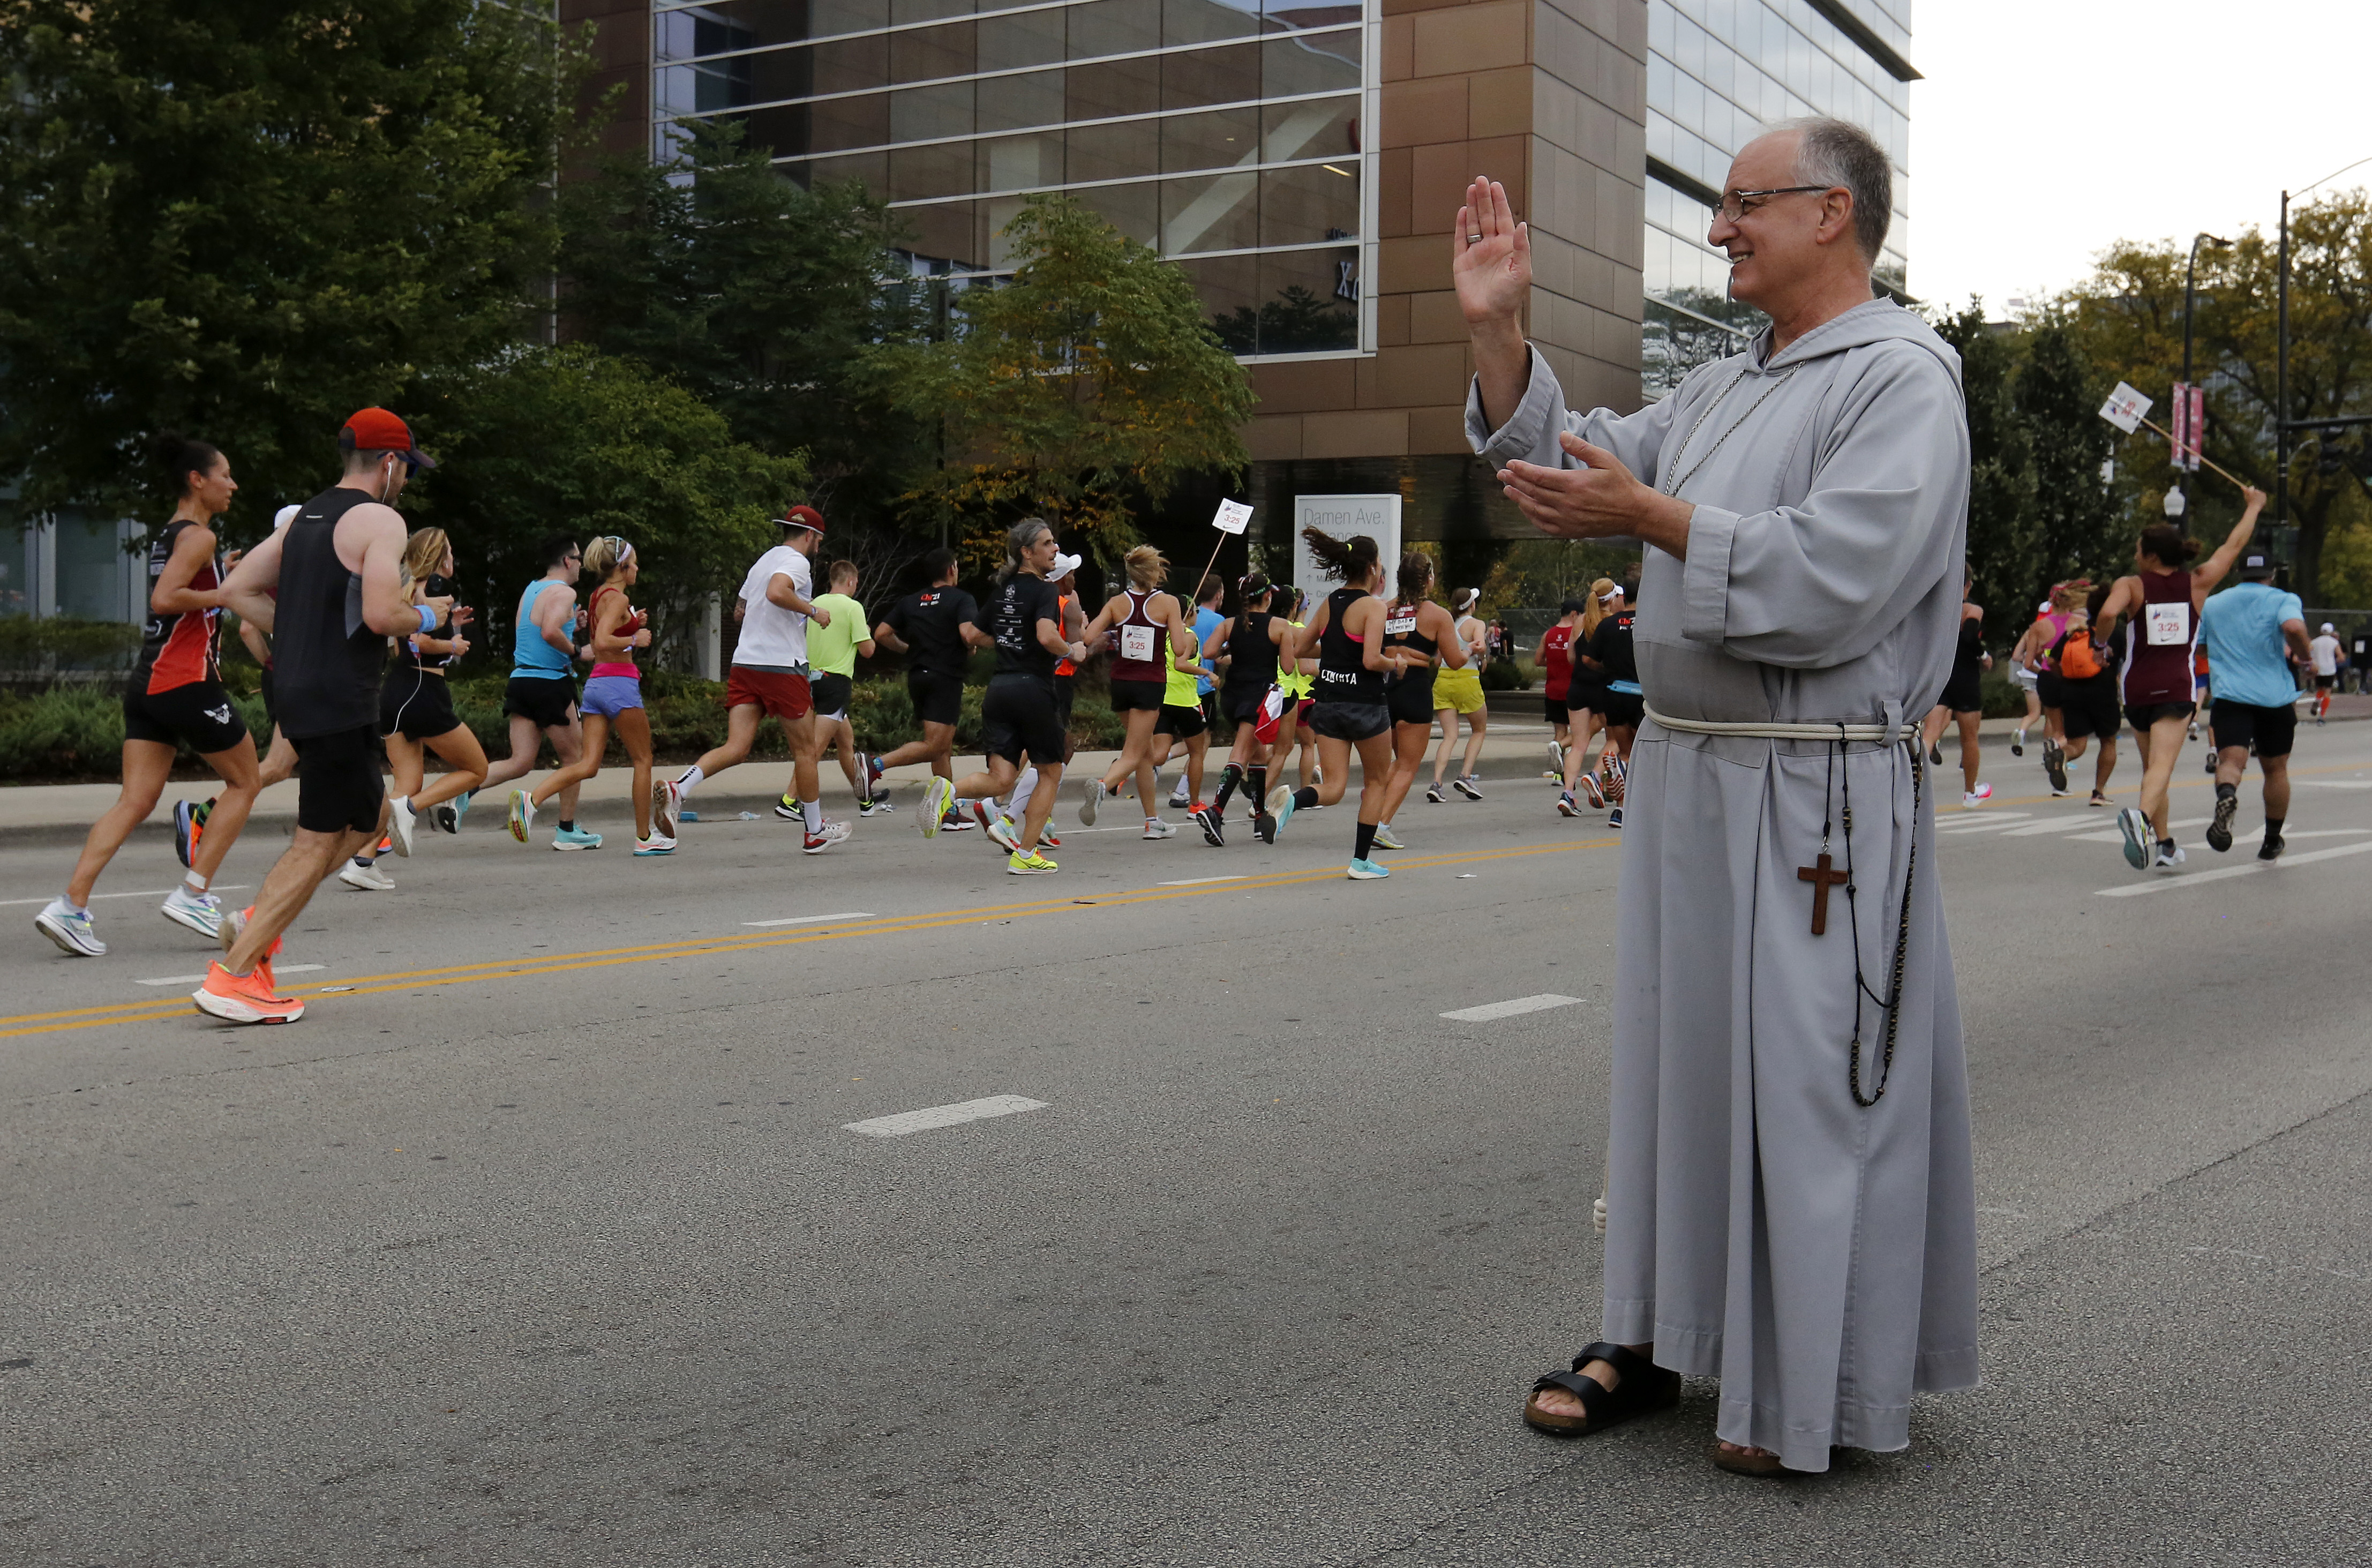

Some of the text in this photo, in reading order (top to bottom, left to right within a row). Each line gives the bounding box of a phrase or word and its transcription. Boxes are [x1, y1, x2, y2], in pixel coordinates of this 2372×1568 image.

[1224, 514, 1241, 525] 3:25
[1304, 508, 1385, 525] Damen Ave.
[2158, 622, 2180, 633] 3:25
[1129, 641, 1145, 650] 3:25
[1214, 769, 1230, 804] MEXI
